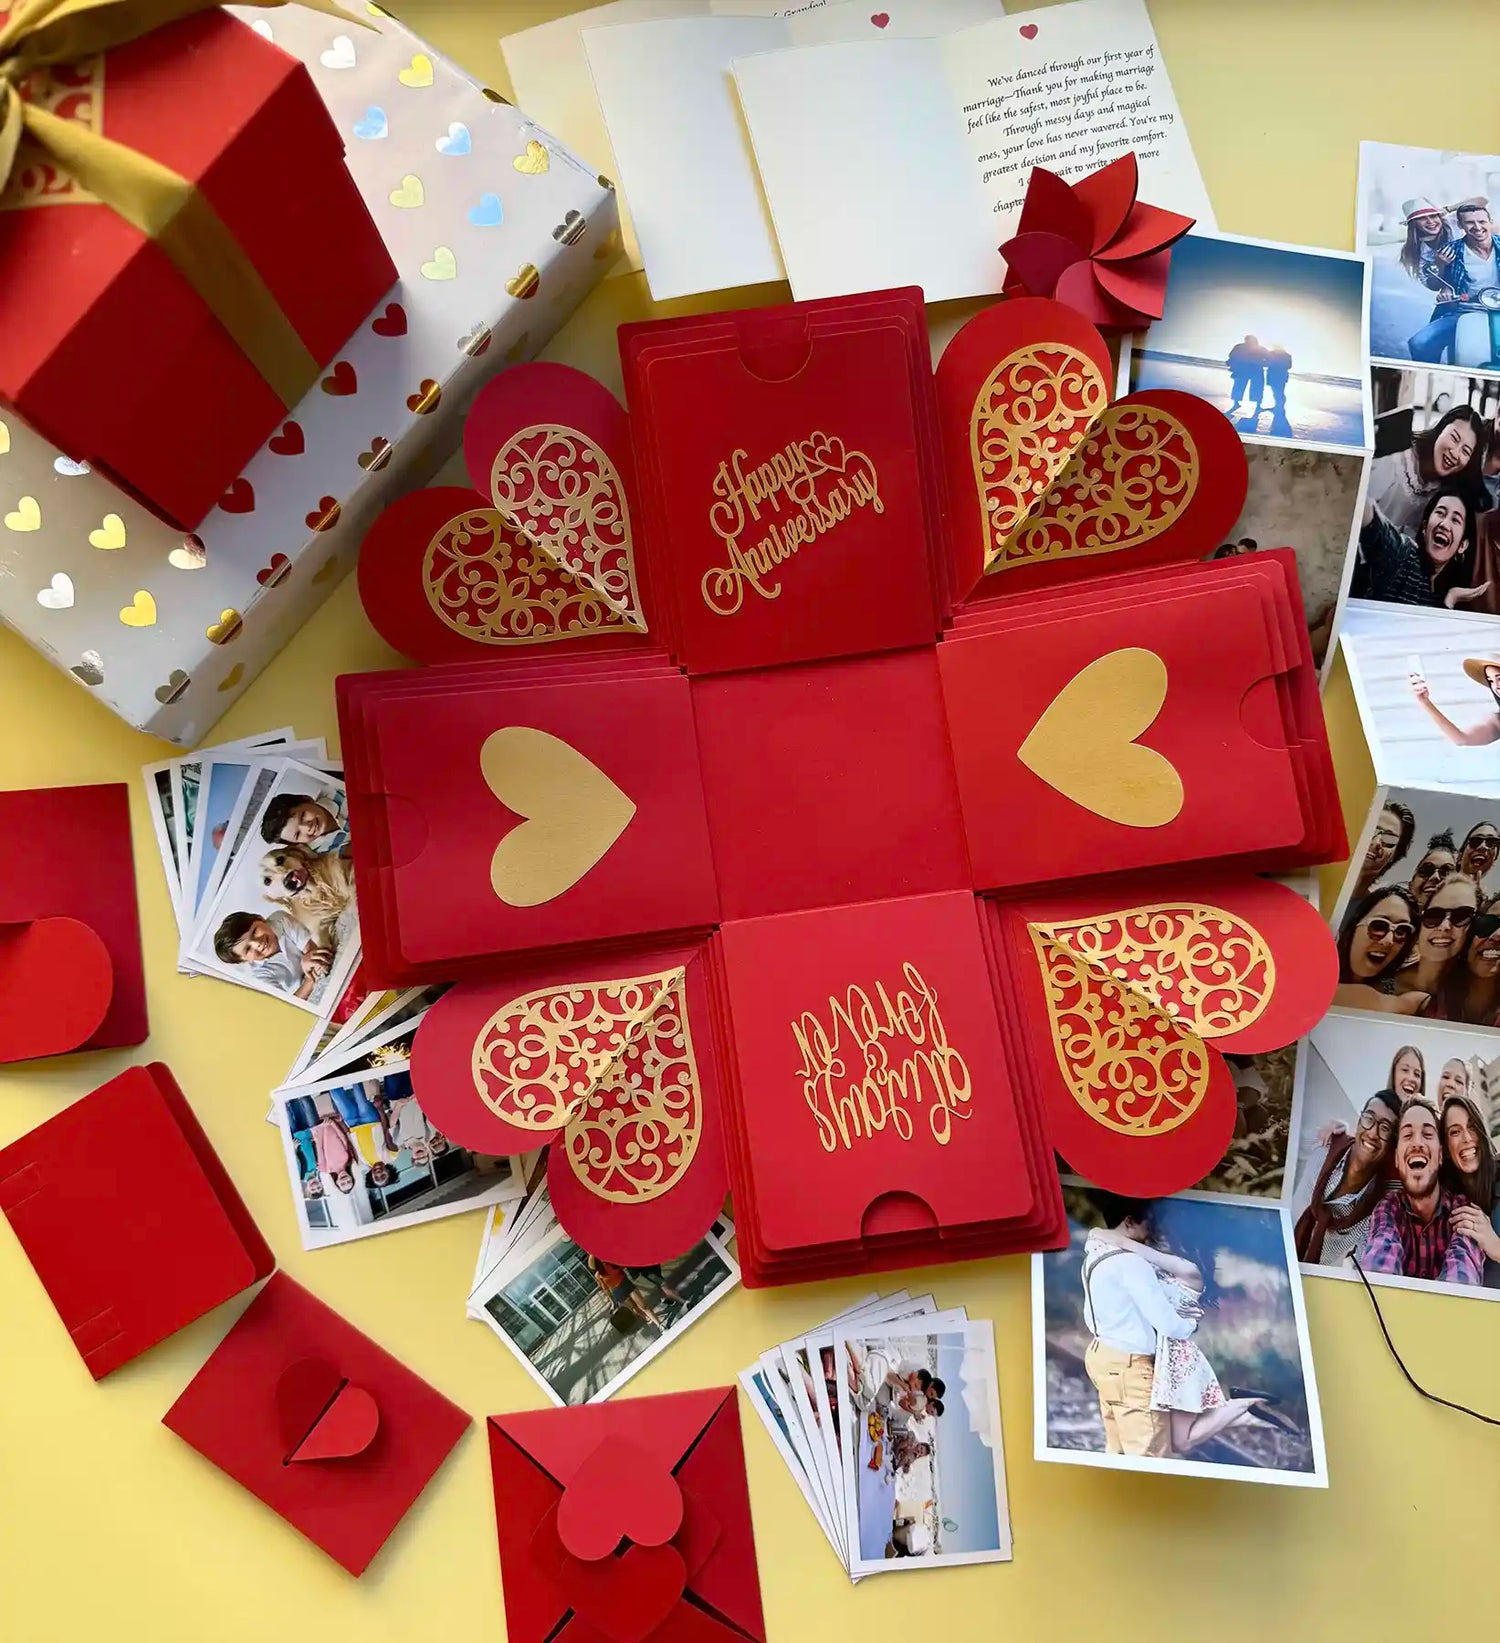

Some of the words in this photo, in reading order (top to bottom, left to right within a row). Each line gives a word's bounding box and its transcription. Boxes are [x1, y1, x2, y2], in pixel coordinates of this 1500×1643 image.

[987, 75, 1013, 87] We've
[1016, 63, 1047, 81] danced
[1050, 56, 1084, 72] through
[1086, 56, 1101, 65] our
[1104, 51, 1122, 66] first
[1124, 50, 1143, 63] year
[1146, 44, 1154, 59] of
[1046, 83, 1062, 95] you
[1064, 76, 1077, 91] for
[1080, 70, 1114, 82] making
[1115, 65, 1154, 76] marriage
[967, 115, 983, 134] feel
[985, 111, 1001, 124] like
[1003, 107, 1017, 119] the
[1020, 101, 1048, 117] safest,
[1050, 96, 1071, 107] most
[1073, 87, 1099, 107] joyful
[1101, 85, 1122, 101] place
[1125, 85, 1133, 93] to
[1136, 80, 1147, 90] be.
[1003, 118, 1042, 137] Through
[1045, 114, 1072, 126] messy
[1074, 108, 1095, 121] days
[1097, 102, 1114, 114] and
[1117, 96, 1151, 113] magical
[978, 151, 1000, 162] ones,
[1002, 143, 1024, 160] your
[1026, 138, 1044, 149] love
[1046, 133, 1062, 144] has
[1065, 128, 1088, 139] never
[1091, 117, 1128, 134] wavered.
[1130, 115, 1157, 127] You're
[1160, 113, 1174, 124] my
[983, 163, 1018, 183] greatest
[1021, 153, 1057, 169] decision
[1059, 144, 1077, 158] and
[1080, 145, 1094, 156] my
[1096, 137, 1130, 155] favorite
[1132, 130, 1167, 145] comfort.
[1085, 159, 1107, 170] write
[1139, 149, 1160, 160] more
[710, 446, 820, 539] Happy
[701, 451, 885, 616] Anniversary
[791, 961, 948, 1078] forever
